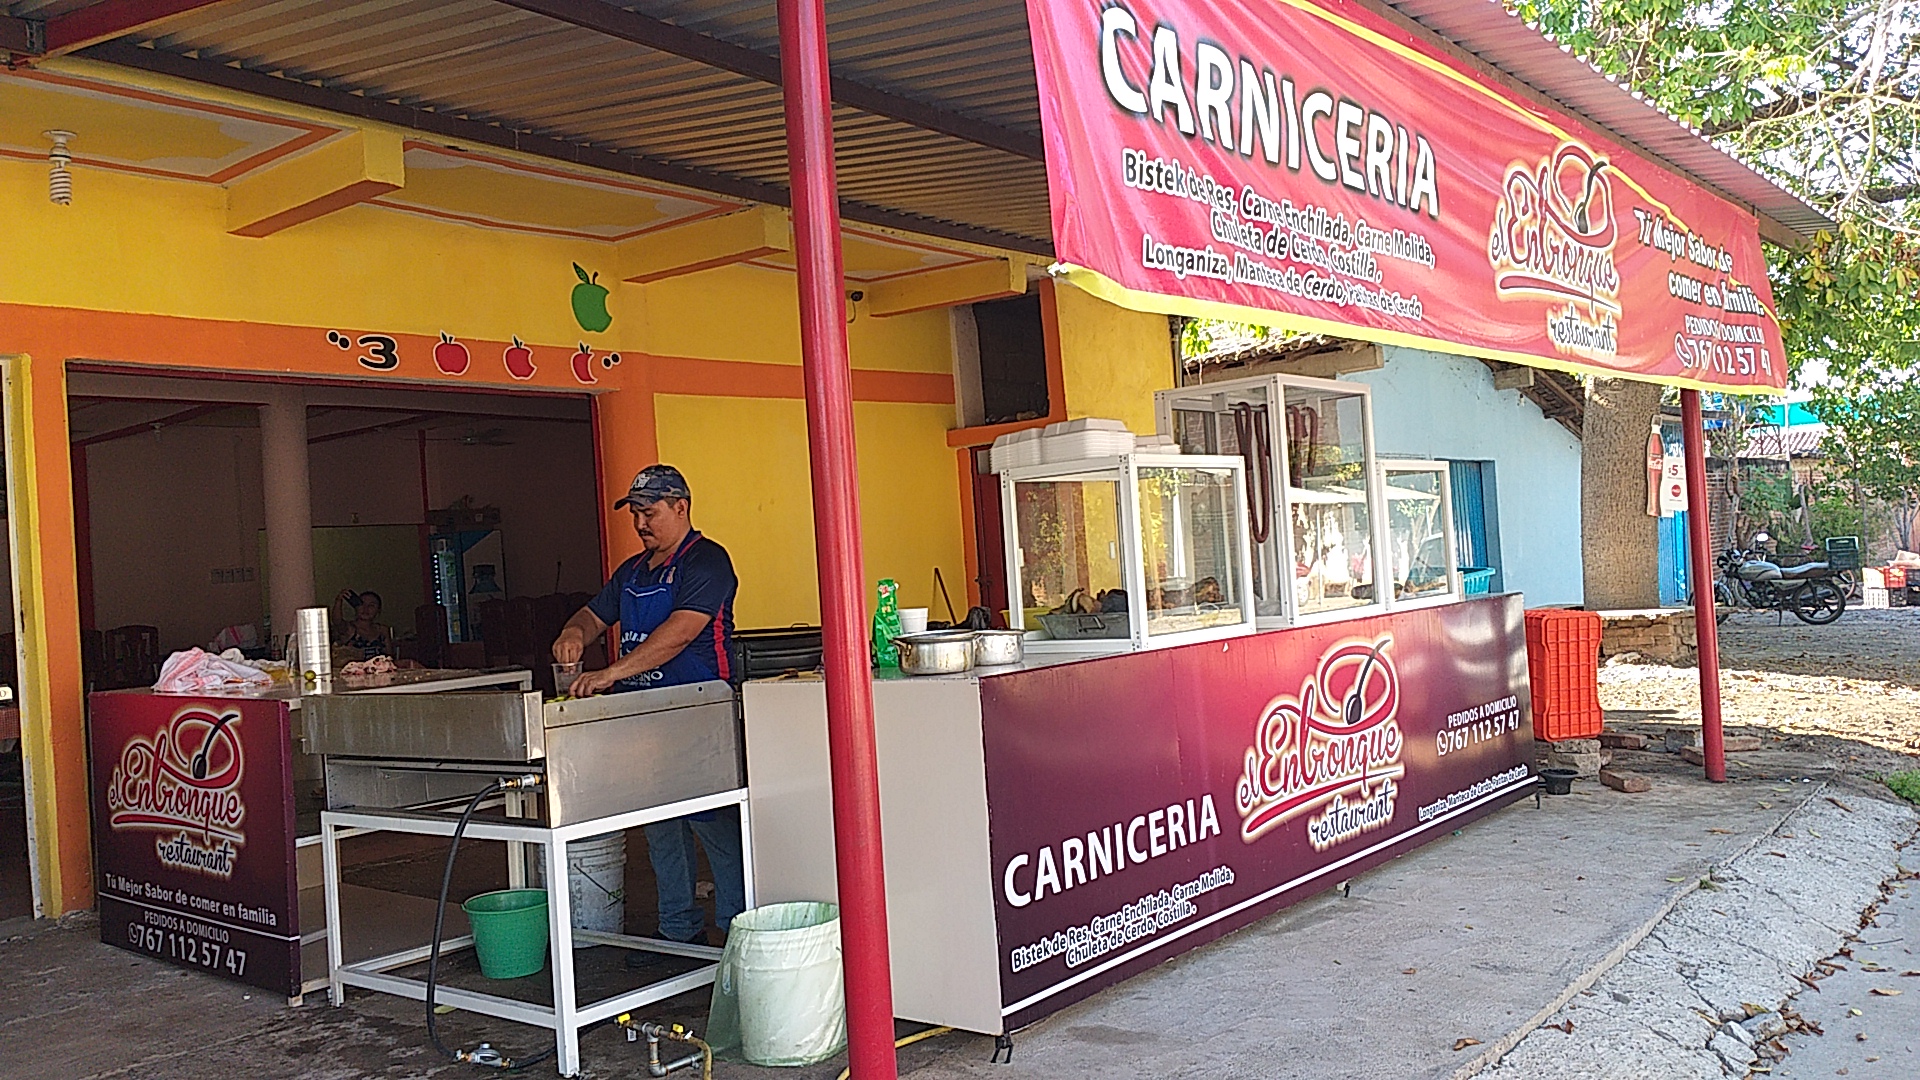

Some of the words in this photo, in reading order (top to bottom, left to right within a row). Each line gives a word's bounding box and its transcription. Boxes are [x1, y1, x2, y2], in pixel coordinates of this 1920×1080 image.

[1100, 6, 1440, 217] CARNICERIA
[1124, 150, 1187, 196] Bistek
[1189, 168, 1207, 203] de
[1205, 176, 1237, 215] Res,
[1242, 187, 1283, 226] Carne
[1283, 201, 1354, 248] Enchilada,
[1356, 219, 1391, 254] Carne
[1393, 229, 1435, 268] Molida,
[1491, 208, 1507, 261] el
[1507, 146, 1617, 313] Entronque
[1212, 209, 1263, 253] Chuleta
[1265, 226, 1288, 257] de
[1291, 232, 1331, 270] Cerdo,
[1653, 216, 1685, 262] Mejor
[1688, 230, 1717, 269] Sabor
[1717, 246, 1733, 273] de
[1144, 236, 1232, 282] Longaniza,
[1235, 254, 1285, 289] Manteca
[1285, 267, 1301, 295] de
[1303, 273, 1347, 305] Cerdo,
[1380, 290, 1394, 314] de
[1393, 294, 1422, 319] Cerdo
[1668, 271, 1701, 303] comer
[1704, 281, 1722, 307] en
[357, 334, 399, 370] 3
[1550, 306, 1615, 352] restaurant
[1686, 339, 1712, 371] 767
[1735, 347, 1756, 375] 57
[1240, 756, 1259, 808] el
[1260, 645, 1400, 792] Entronque
[1448, 707, 1478, 728] PEDIDOS
[1479, 706, 1485, 719] A
[1485, 695, 1517, 715] DOMICILIO
[1448, 727, 1469, 752] 767
[1472, 720, 1492, 743] 112
[1494, 714, 1505, 736] 57
[1508, 709, 1519, 730] 47
[110, 771, 121, 806] el
[122, 711, 242, 842] Entronque
[1419, 799, 1448, 820] Longaniza,
[1448, 792, 1470, 808] Manteca
[1470, 785, 1477, 799] de
[1311, 781, 1395, 843] restaurant
[158, 834, 234, 872] restaurant
[1004, 794, 1220, 908] CARNICERIA
[105, 873, 117, 888] Tú
[118, 877, 143, 897] Mejor
[145, 882, 173, 902] Sabor
[175, 889, 188, 905] de
[190, 895, 220, 913] comer
[222, 904, 236, 917] en
[238, 903, 277, 926] familia
[1012, 938, 1051, 970] Bistek
[1051, 931, 1067, 952] de
[1068, 927, 1092, 947] Res,
[1091, 915, 1123, 936] Carne
[1124, 891, 1173, 923] Enchilada,
[1173, 881, 1200, 902] Carne
[1200, 867, 1234, 891] Molida,
[137, 925, 163, 952] 767
[168, 933, 198, 963] 112
[202, 943, 220, 969] 57
[225, 949, 246, 976] 47
[144, 911, 178, 930] PEDIDOS
[179, 920, 185, 931] A
[187, 921, 229, 944] DOMICILIO
[1067, 940, 1109, 966] Chuleta
[1110, 930, 1123, 948] de
[1124, 915, 1156, 941] Cerdo,
